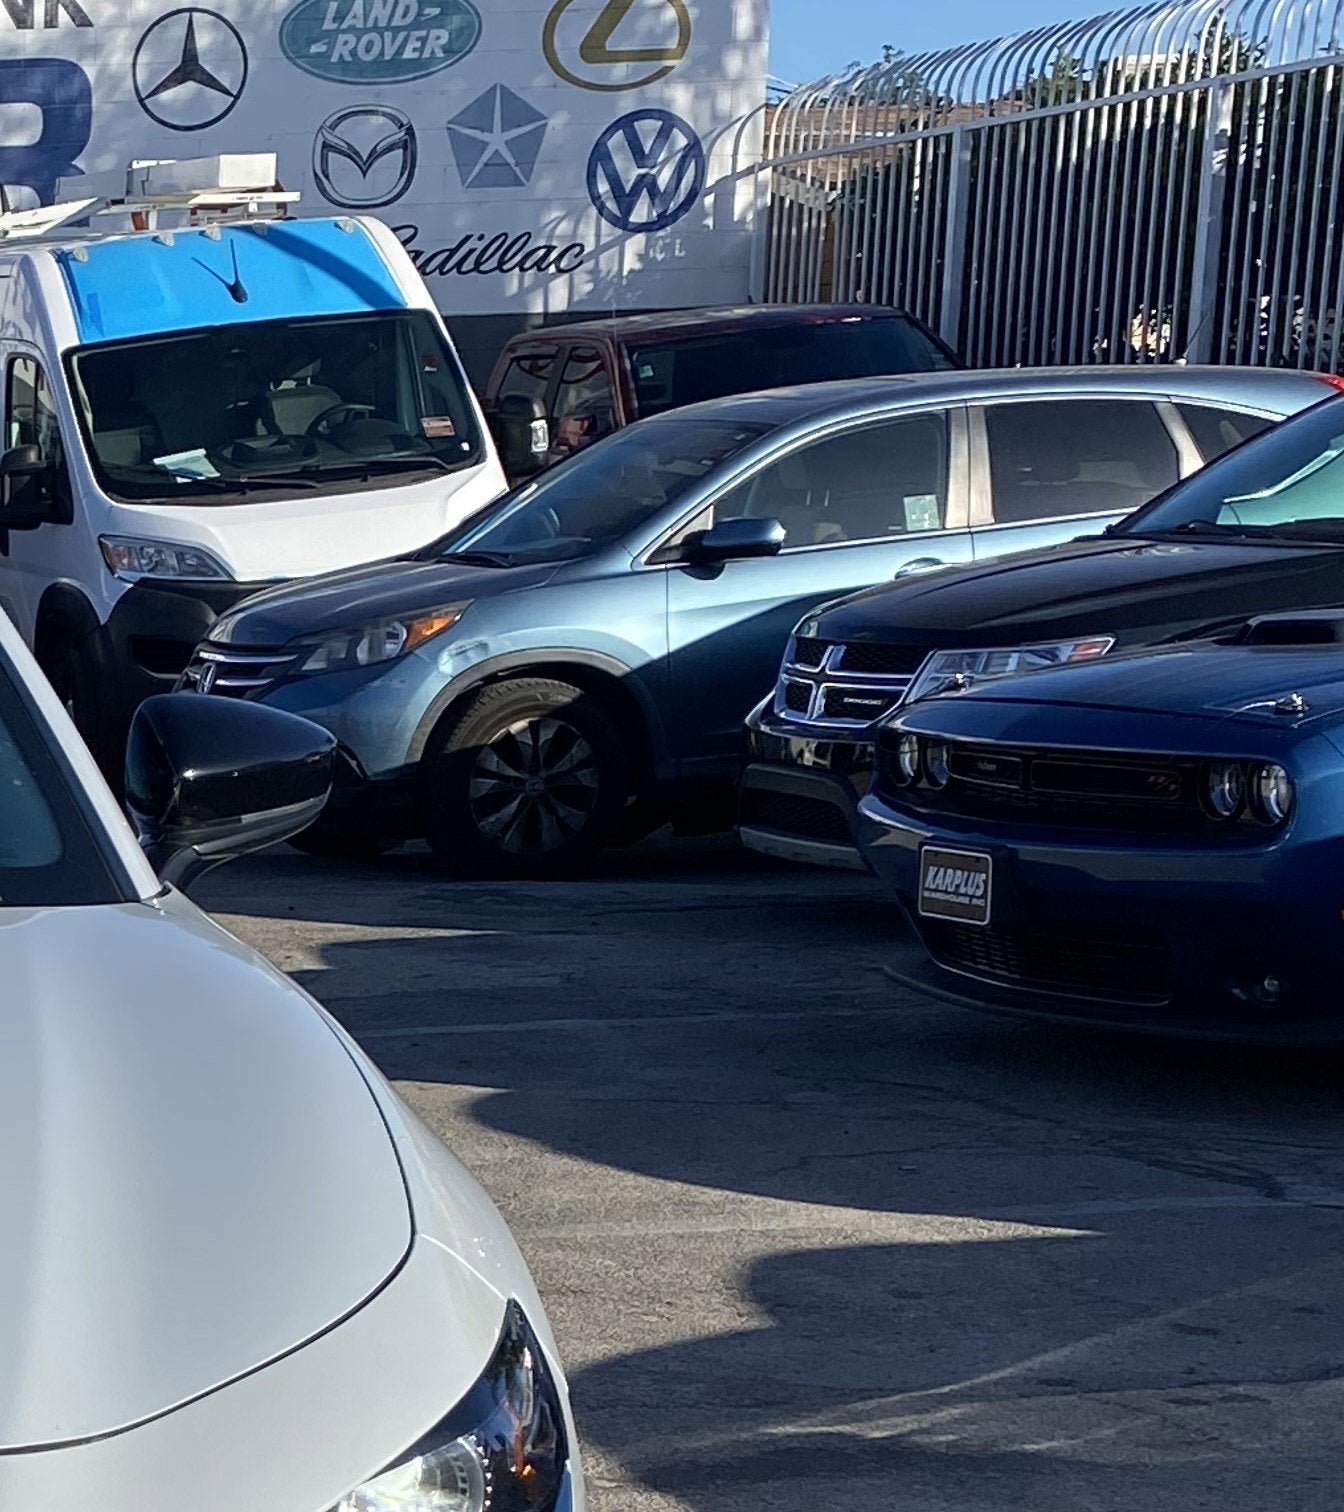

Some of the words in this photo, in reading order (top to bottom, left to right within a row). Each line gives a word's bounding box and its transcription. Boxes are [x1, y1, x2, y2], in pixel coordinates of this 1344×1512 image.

[321, 0, 419, 31] LAND
[329, 28, 450, 63] ROVER
[924, 865, 987, 897] KARPLUS
